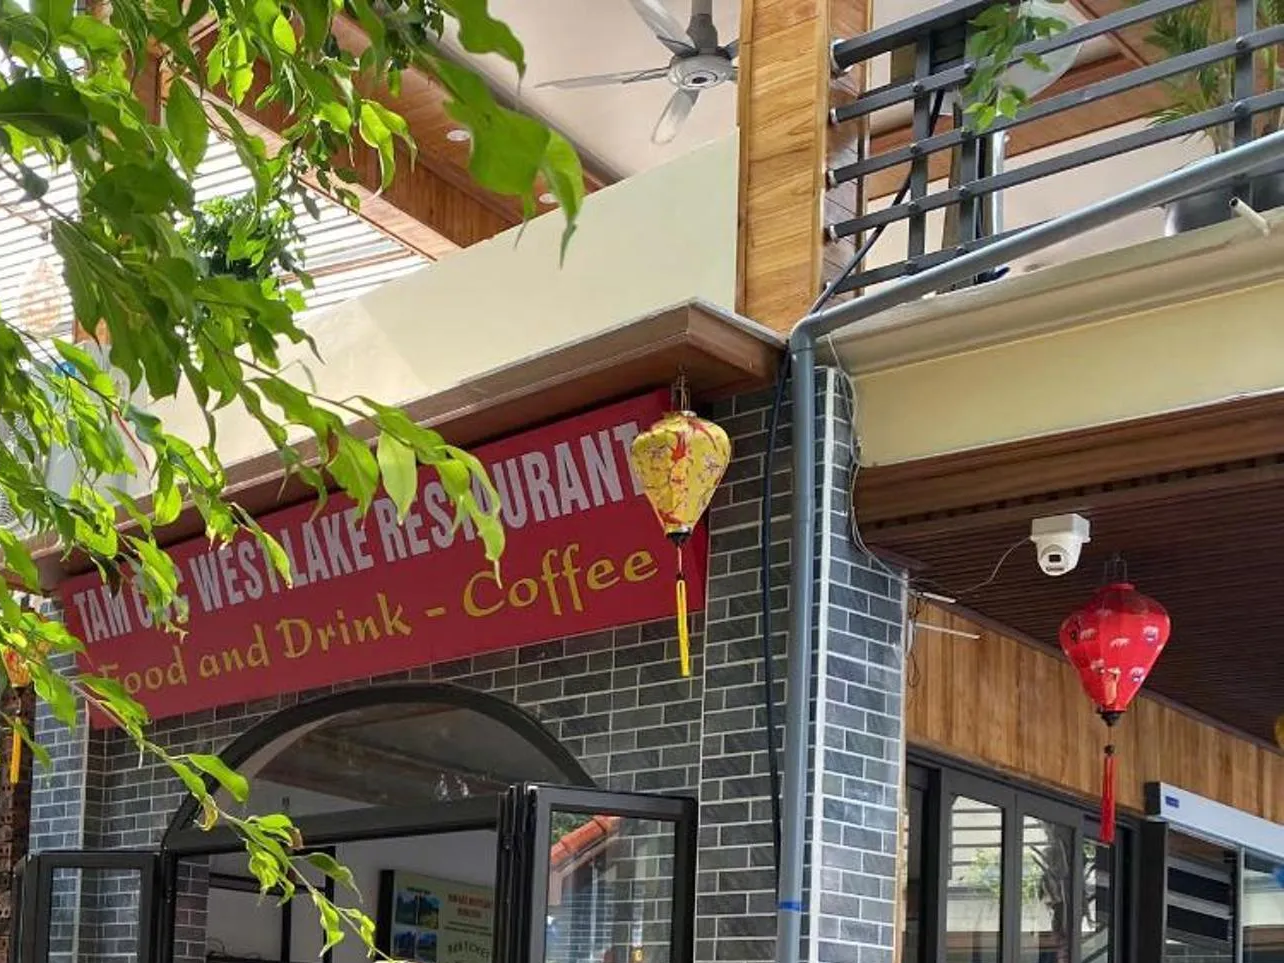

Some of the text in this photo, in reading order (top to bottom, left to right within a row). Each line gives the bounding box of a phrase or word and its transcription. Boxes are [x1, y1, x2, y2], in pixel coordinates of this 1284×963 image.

[73, 583, 133, 644] TAM
[199, 623, 270, 679] and
[275, 592, 413, 659] Drink
[463, 543, 658, 618] Coffee
